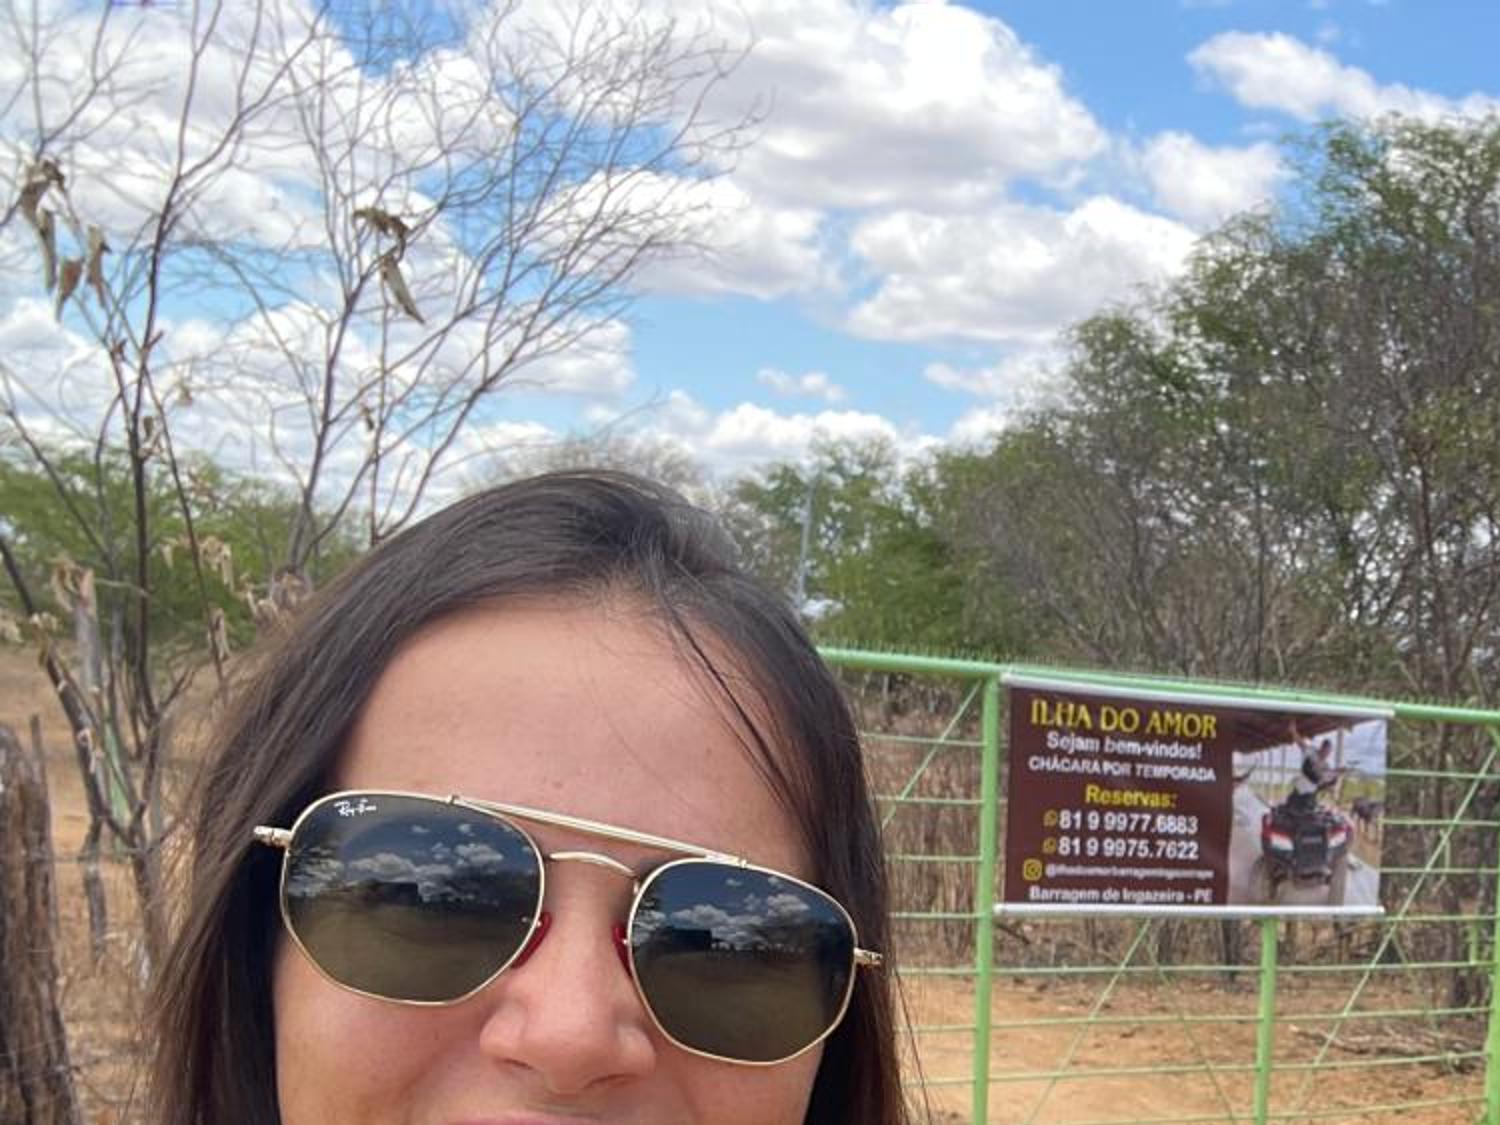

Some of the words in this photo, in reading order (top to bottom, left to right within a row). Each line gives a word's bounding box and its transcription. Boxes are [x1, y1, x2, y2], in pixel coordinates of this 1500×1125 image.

[1031, 698, 1092, 730] ILHA
[1100, 704, 1140, 733] DO
[1146, 710, 1217, 738] AMOR
[1046, 731, 1100, 754] Sejam
[1104, 736, 1202, 759] bem-vindos!
[1102, 760, 1132, 777] POR
[1134, 762, 1217, 782] TEMPORADA
[334, 798, 376, 816] Ray-Ban
[1085, 784, 1177, 808] Reservas:
[1058, 810, 1082, 830] 81
[1087, 811, 1100, 831] 9
[1057, 836, 1081, 857] 81
[1085, 837, 1099, 857] 9
[1103, 837, 1199, 860] 9975.7622
[1102, 886, 1121, 902] de
[1193, 888, 1213, 902] PE
